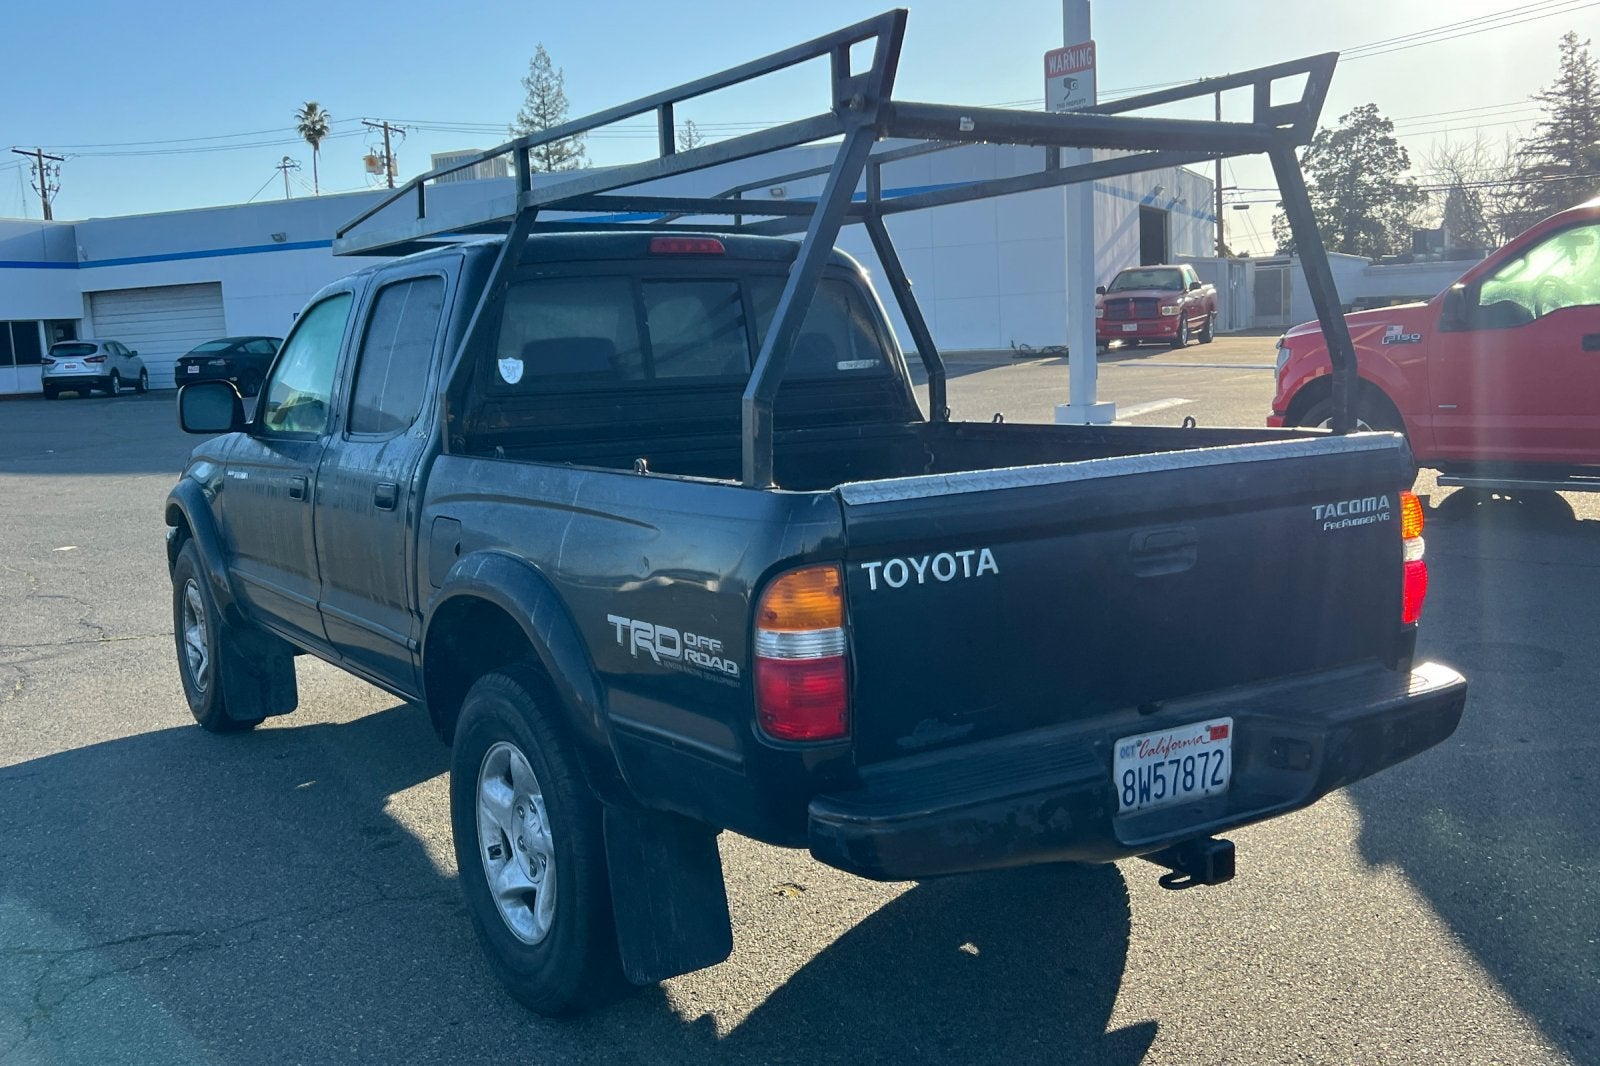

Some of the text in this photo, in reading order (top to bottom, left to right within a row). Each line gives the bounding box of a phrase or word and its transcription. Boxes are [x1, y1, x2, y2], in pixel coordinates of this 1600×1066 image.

[1049, 47, 1092, 73] WARNING
[1312, 495, 1390, 520] TACOMA
[1376, 512, 1390, 522] V6
[861, 548, 999, 591] TOYOTA
[607, 614, 682, 663] TRD
[683, 631, 722, 650] OFF
[683, 649, 739, 675] ROAD
[1139, 735, 1209, 759] California
[1122, 748, 1225, 807] 8W57872
